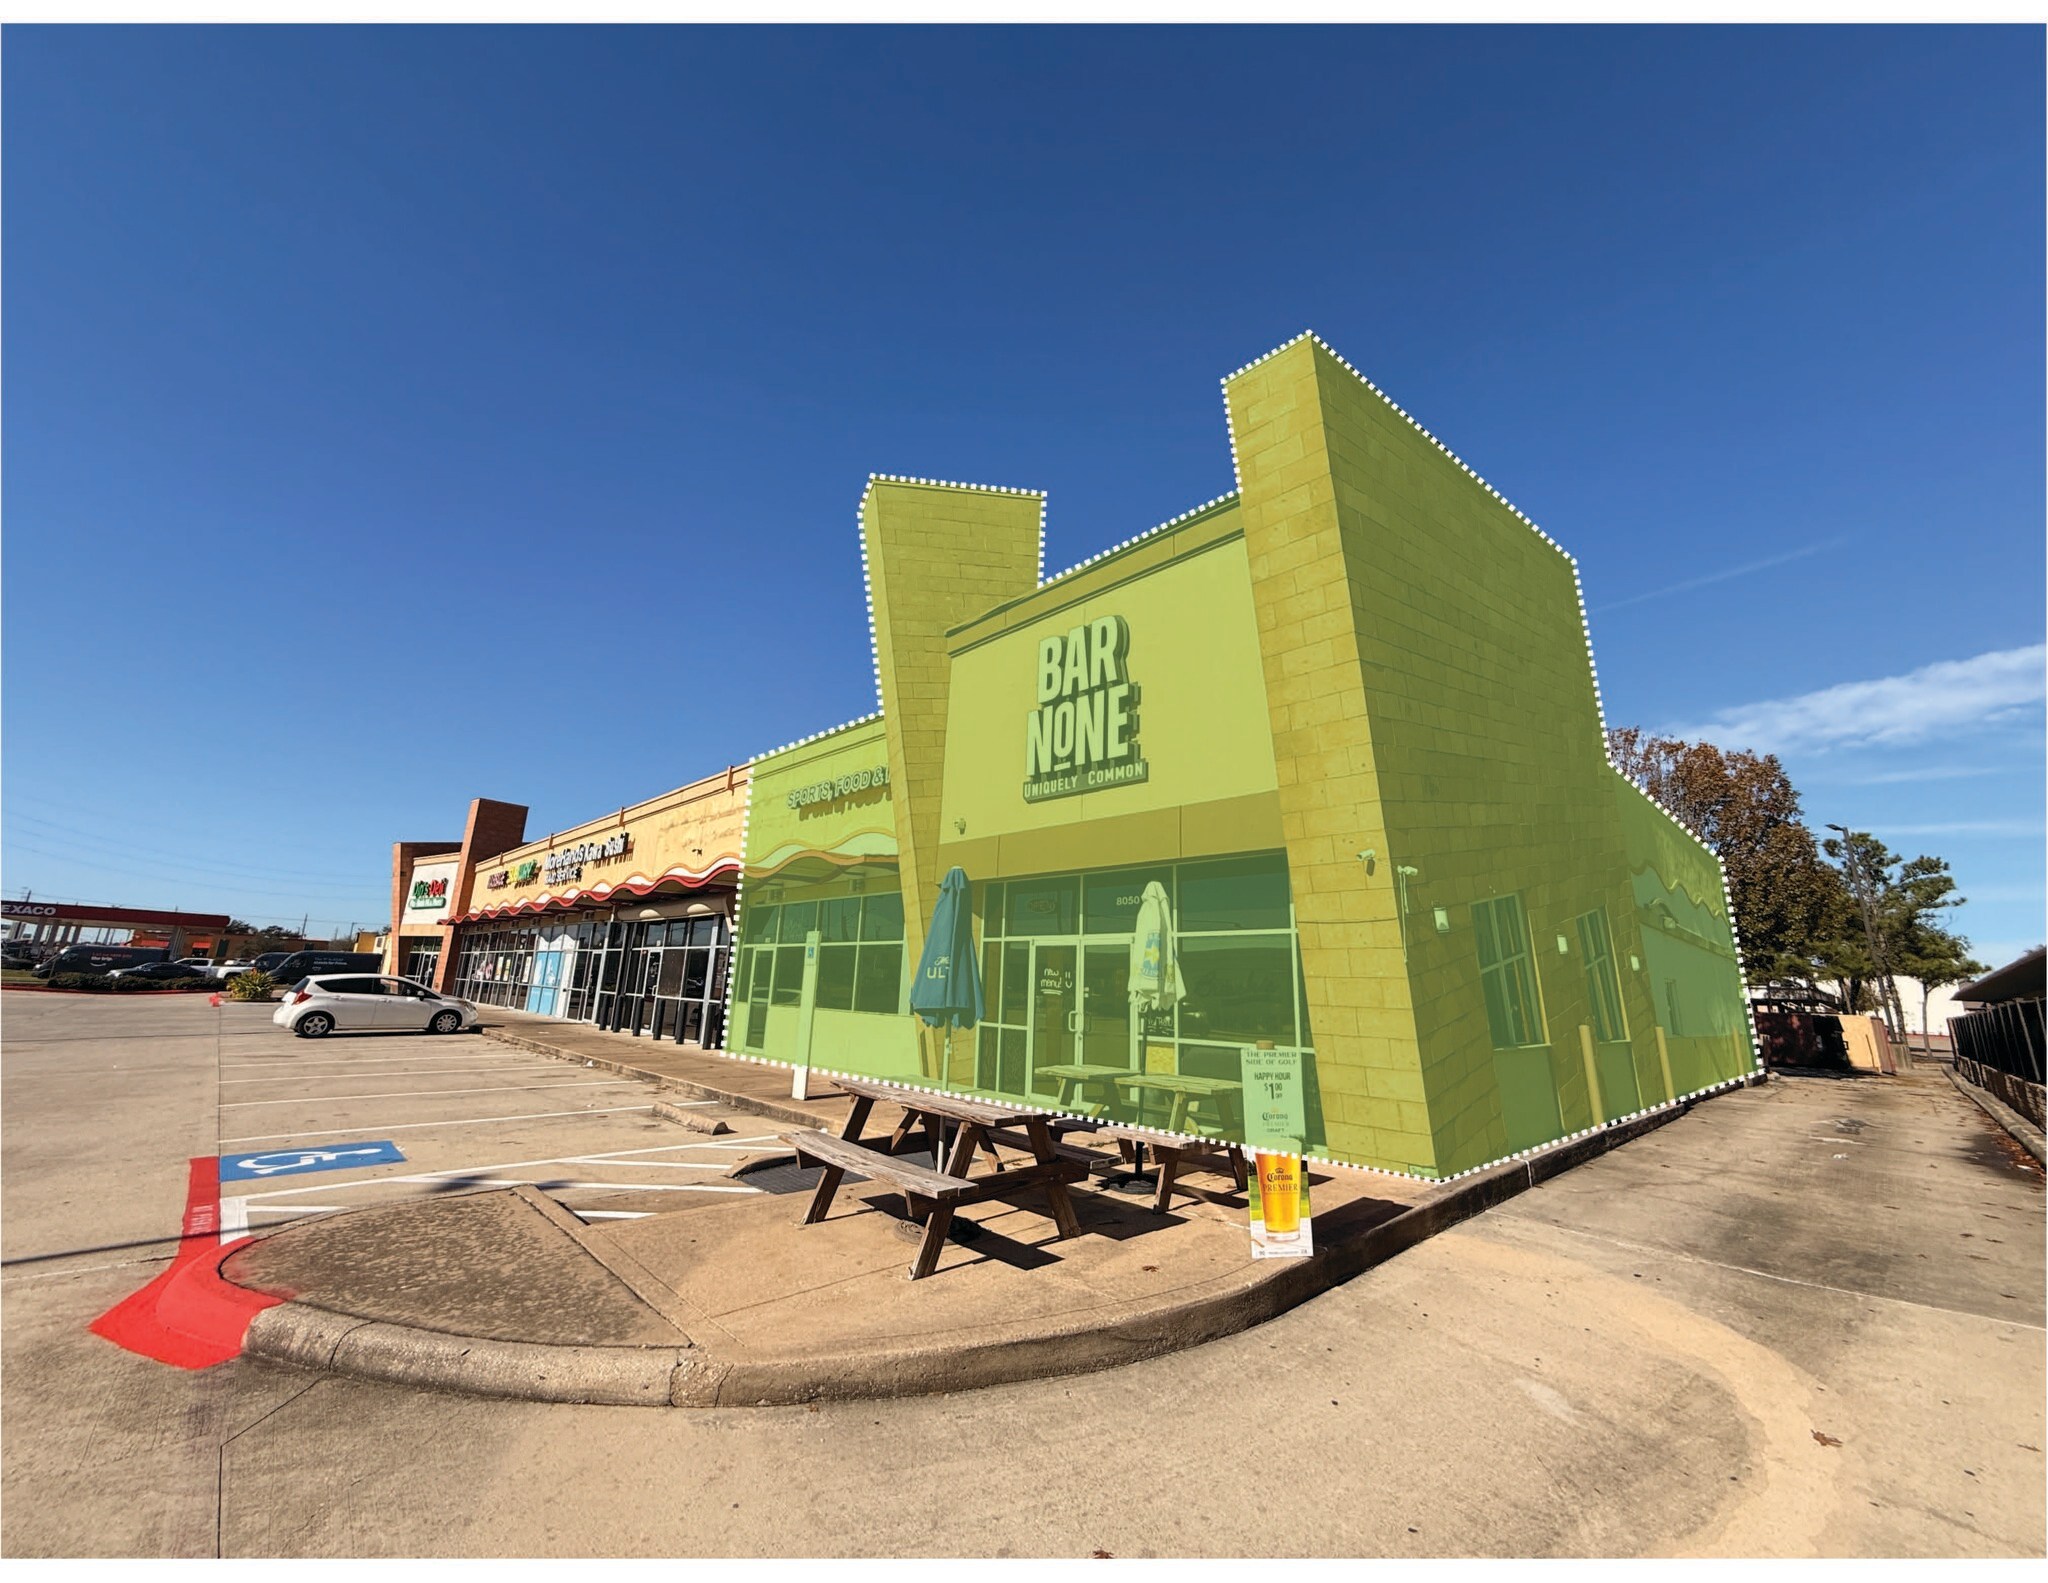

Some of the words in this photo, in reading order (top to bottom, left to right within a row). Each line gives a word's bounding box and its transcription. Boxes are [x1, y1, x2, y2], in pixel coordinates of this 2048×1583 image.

[1037, 615, 1120, 704] BAR
[1026, 683, 1130, 776] NONE
[1024, 775, 1079, 797] UNIQUELY
[1088, 762, 1144, 785] COMMON
[787, 780, 833, 808] SPORTS,
[834, 769, 871, 797] FOOD
[872, 766, 884, 787] &
[1116, 895, 1140, 906] 8050
[1254, 1072, 1274, 1080] HAPPY
[1274, 1072, 1292, 1080] HOUR
[1262, 1112, 1288, 1121] Corona
[1266, 1172, 1293, 1183] Corona
[1262, 1183, 1299, 1192] PREMIER
